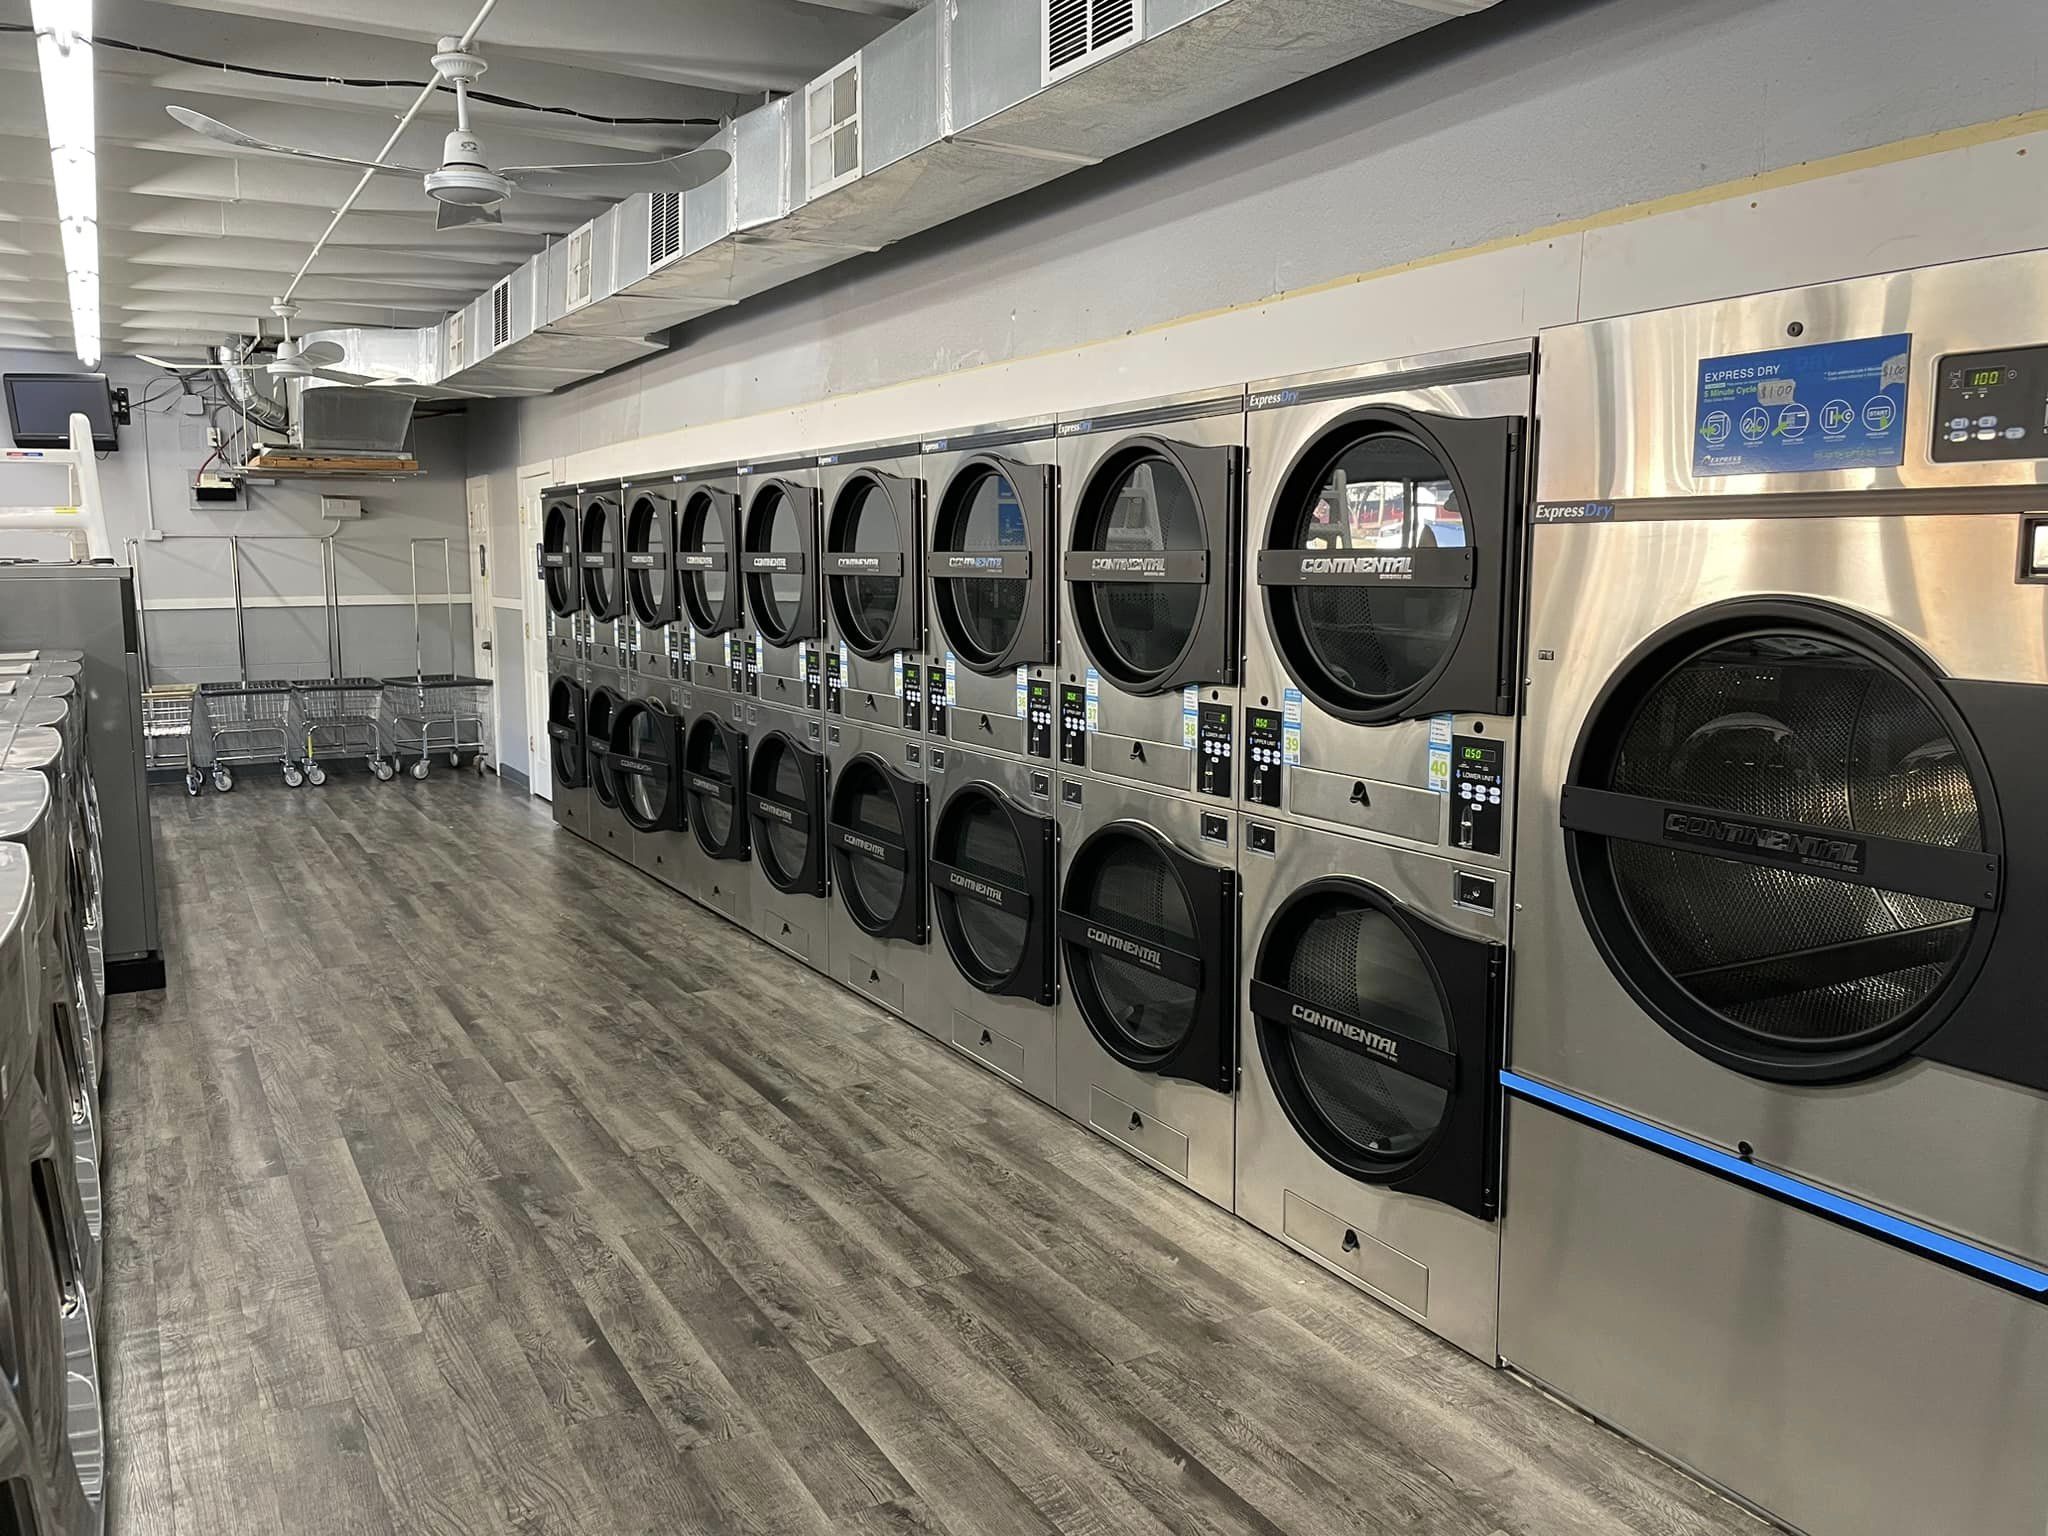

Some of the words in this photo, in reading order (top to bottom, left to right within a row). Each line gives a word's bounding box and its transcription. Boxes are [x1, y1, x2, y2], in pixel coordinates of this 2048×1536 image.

[1704, 367, 1754, 383] EXPRESS
[1757, 364, 1780, 377] DRY
[1249, 390, 1299, 408] ExpressDry
[1711, 387, 1735, 397] Minute
[1736, 384, 1758, 396] Cycle
[1870, 409, 1888, 417] START
[1536, 502, 1613, 521] ExpressDry
[1092, 558, 1165, 571] CONTINENTAL
[1301, 557, 1412, 573] CONTINENTAL
[1184, 722, 1196, 737] 38
[1285, 736, 1299, 752] 39
[1430, 759, 1448, 777] 40
[1462, 771, 1481, 780] LOWER
[1664, 813, 1860, 864] CONTINENTAL
[950, 872, 1002, 902] CONTINENTAL
[1087, 927, 1161, 965] CONTINENTAL
[1291, 1003, 1398, 1056] CONTINENTAL
